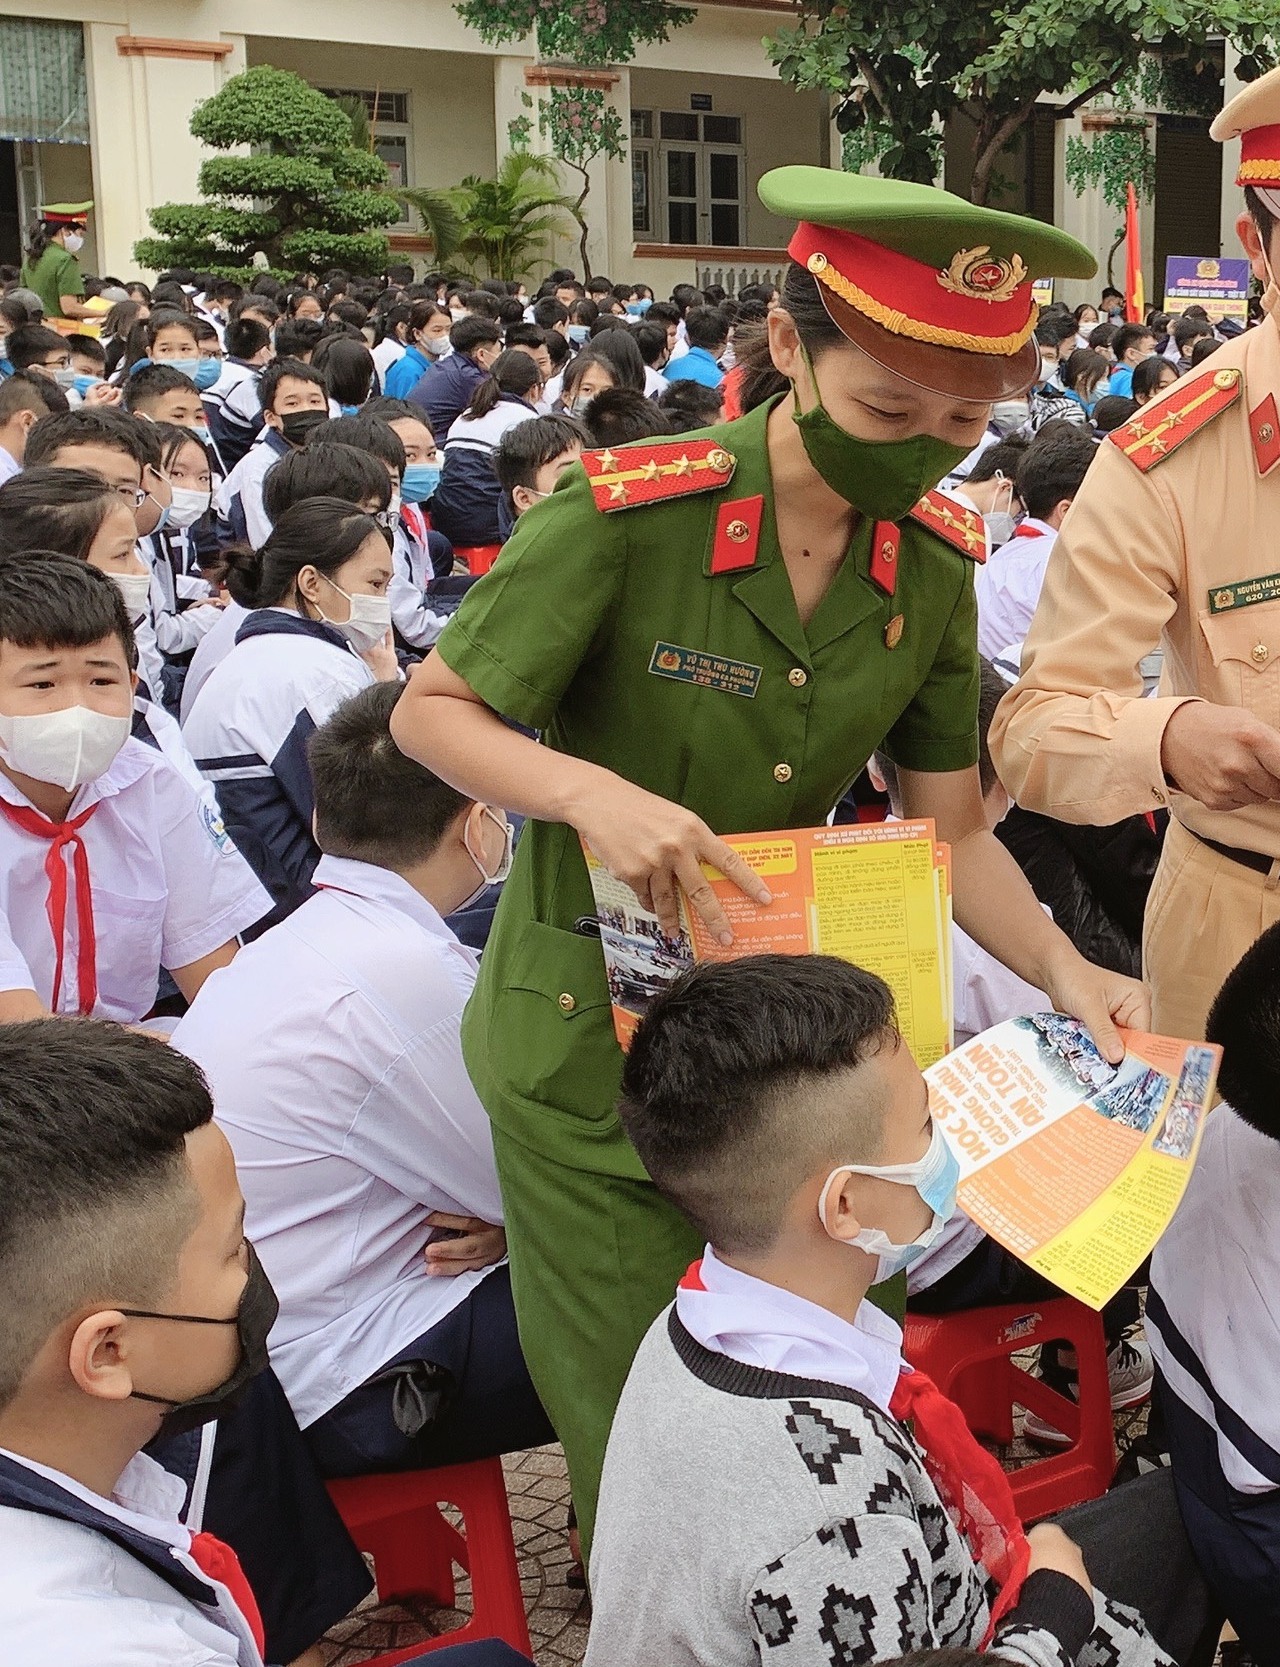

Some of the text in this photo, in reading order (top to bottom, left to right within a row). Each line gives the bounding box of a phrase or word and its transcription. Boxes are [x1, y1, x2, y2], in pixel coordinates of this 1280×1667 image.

[713, 661, 727, 672] THU
[965, 1042, 1018, 1099] TOÀN
[1003, 1059, 1019, 1075] QUY
[973, 1082, 992, 1101] GIAO
[1031, 1092, 1047, 1110] THEO
[988, 1101, 1003, 1115] GIA
[1009, 1095, 1045, 1128] AN
[999, 1114, 1022, 1136] THAM
[946, 1117, 991, 1162] HỌC
